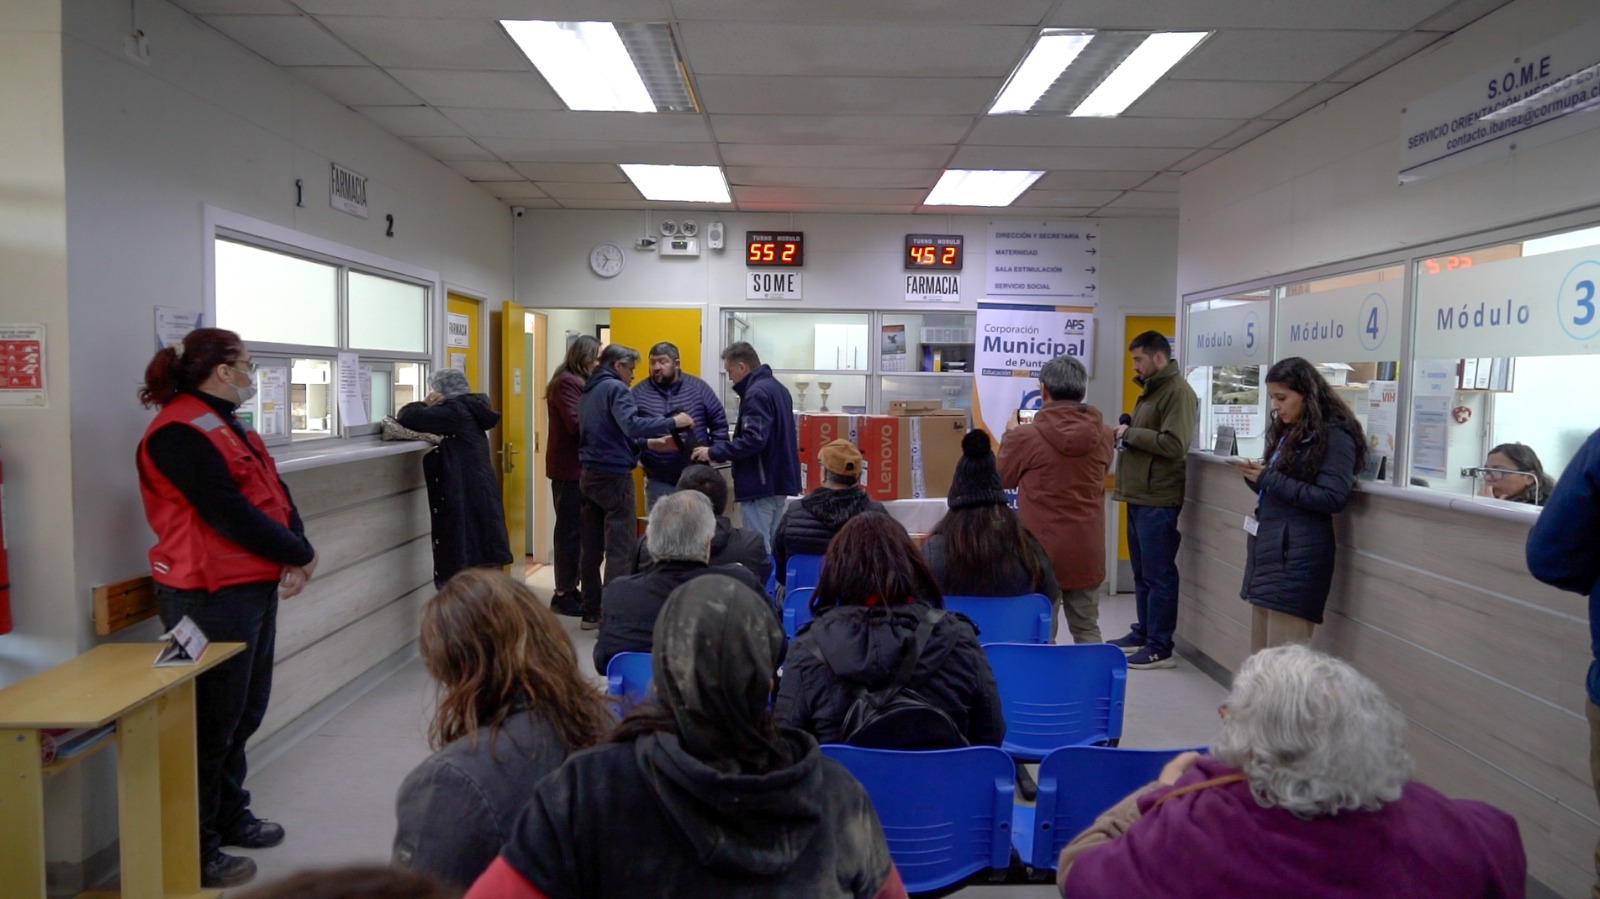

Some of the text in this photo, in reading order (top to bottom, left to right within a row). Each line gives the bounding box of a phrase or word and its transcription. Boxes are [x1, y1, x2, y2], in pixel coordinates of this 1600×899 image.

[1487, 55, 1551, 99] S.O.M.E
[1407, 123, 1449, 150] SERVICIO
[295, 178, 305, 208] 1
[331, 164, 368, 208] FARMACIA
[386, 213, 394, 238] 2
[995, 231, 1032, 239] DIRECCIÓN
[1038, 231, 1080, 240] SECRETARÍA
[750, 243, 795, 261] 55 2
[911, 247, 956, 264] 45 2
[753, 273, 795, 293] SOME
[906, 275, 959, 295] FARMACIA
[1437, 279, 1596, 331] Módulo 3
[983, 323, 1040, 334] Corporación
[1064, 319, 1085, 330] APS
[1290, 306, 1379, 342] Módulo 4
[1196, 322, 1254, 349] Módulo 5
[983, 336, 1085, 358] Municipal
[1005, 358, 1046, 368] de Punt
[1382, 392, 1396, 403] VIH
[877, 424, 893, 494] Lenovo
